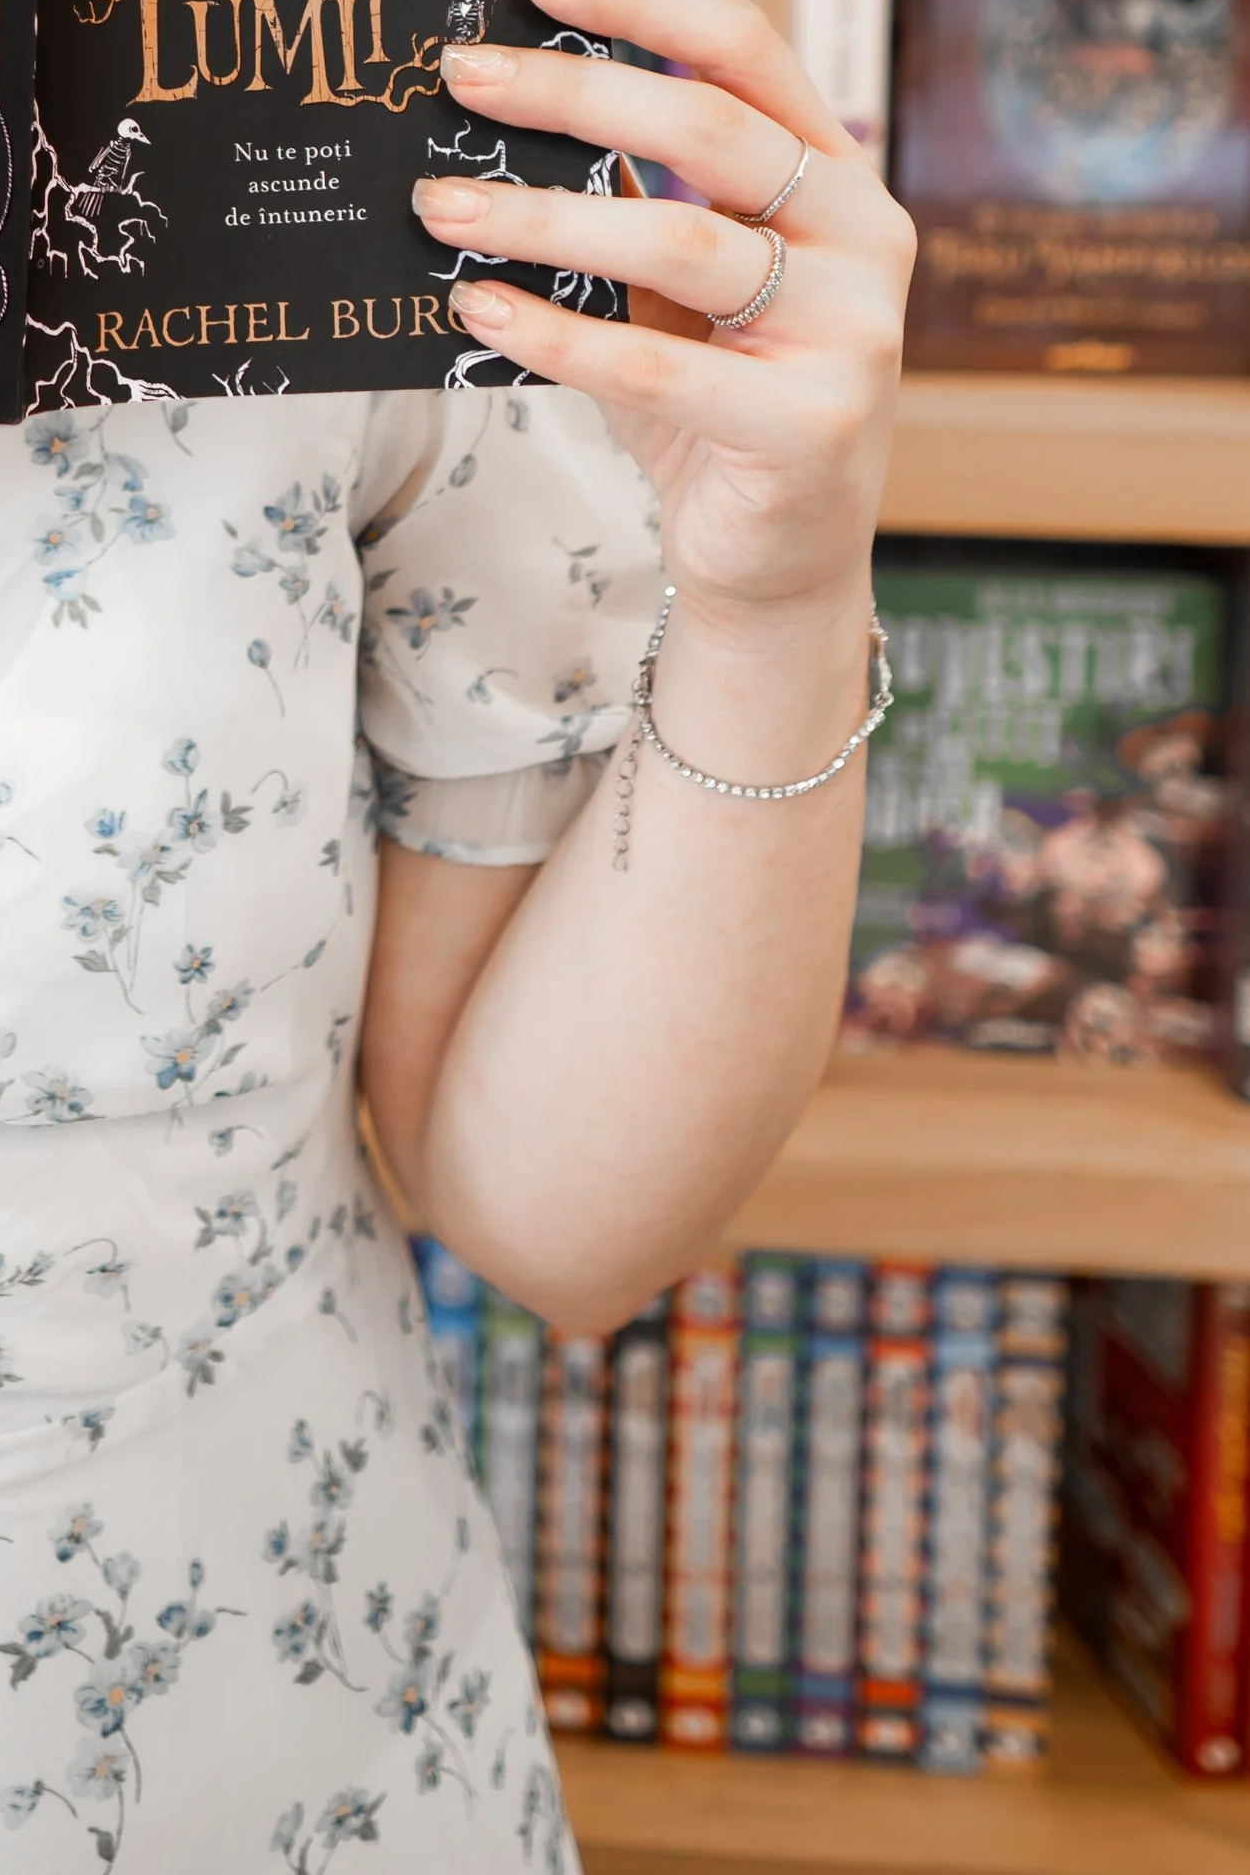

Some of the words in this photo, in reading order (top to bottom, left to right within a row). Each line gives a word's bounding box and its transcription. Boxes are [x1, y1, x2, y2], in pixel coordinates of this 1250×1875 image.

[233, 141, 269, 162] Nu
[276, 145, 297, 160] te
[305, 139, 352, 166] poți
[248, 170, 340, 194] ascunde
[225, 206, 251, 227] de
[258, 203, 367, 225] întuneric
[95, 301, 310, 354] RACHEL
